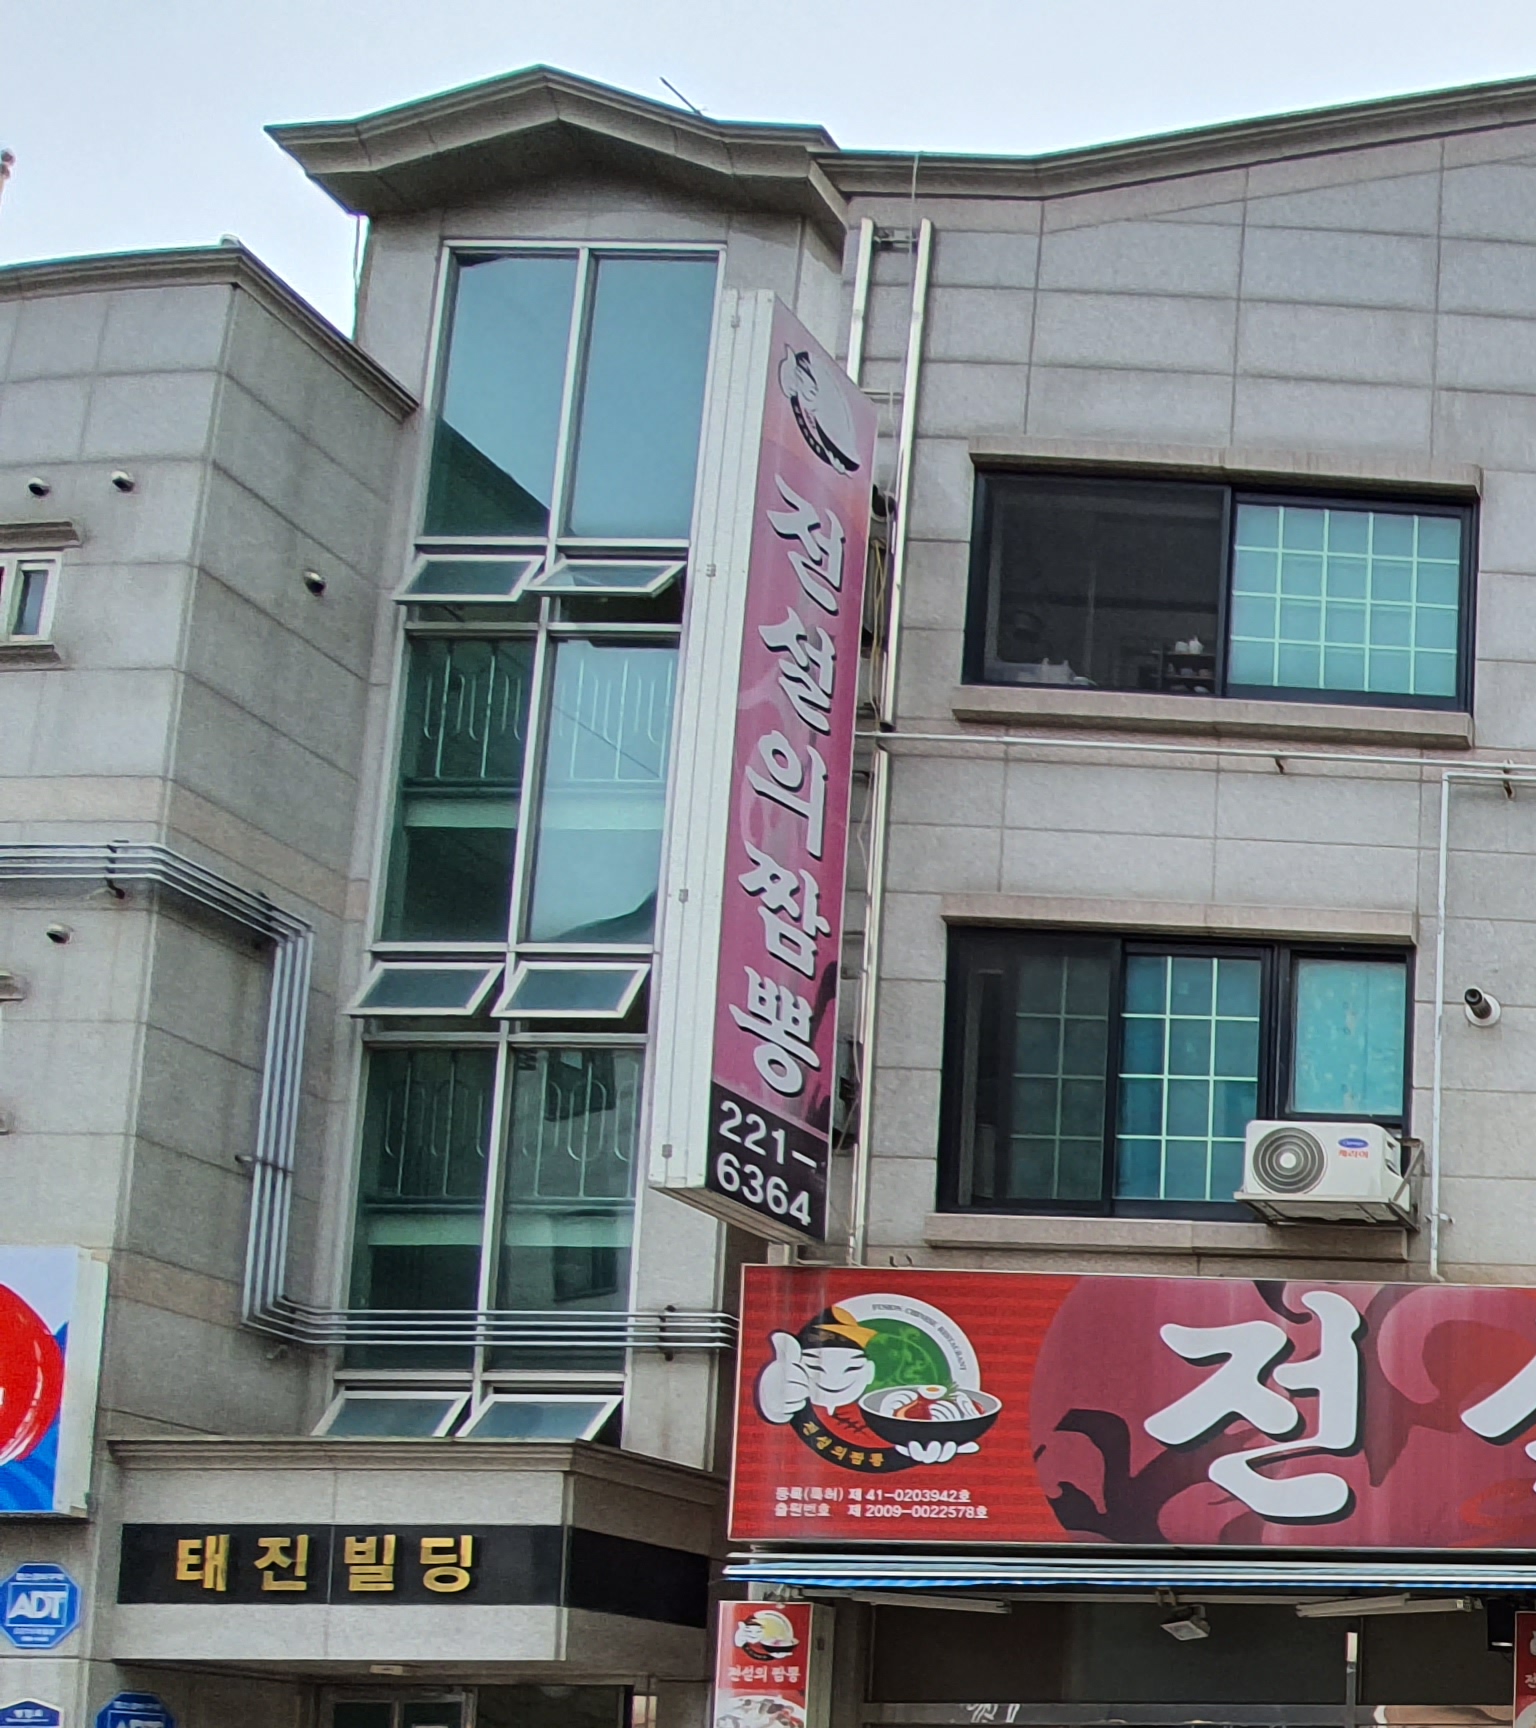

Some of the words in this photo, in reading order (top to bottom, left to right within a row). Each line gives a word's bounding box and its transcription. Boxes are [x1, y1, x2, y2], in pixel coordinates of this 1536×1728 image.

[718, 1100, 818, 1169] 221-
[716, 1151, 812, 1227] 6364
[847, 1487, 863, 1502] 제
[847, 1503, 862, 1518] 제
[174, 1533, 475, 1594] 태진빌딩
[8, 1590, 67, 1619] ADT
